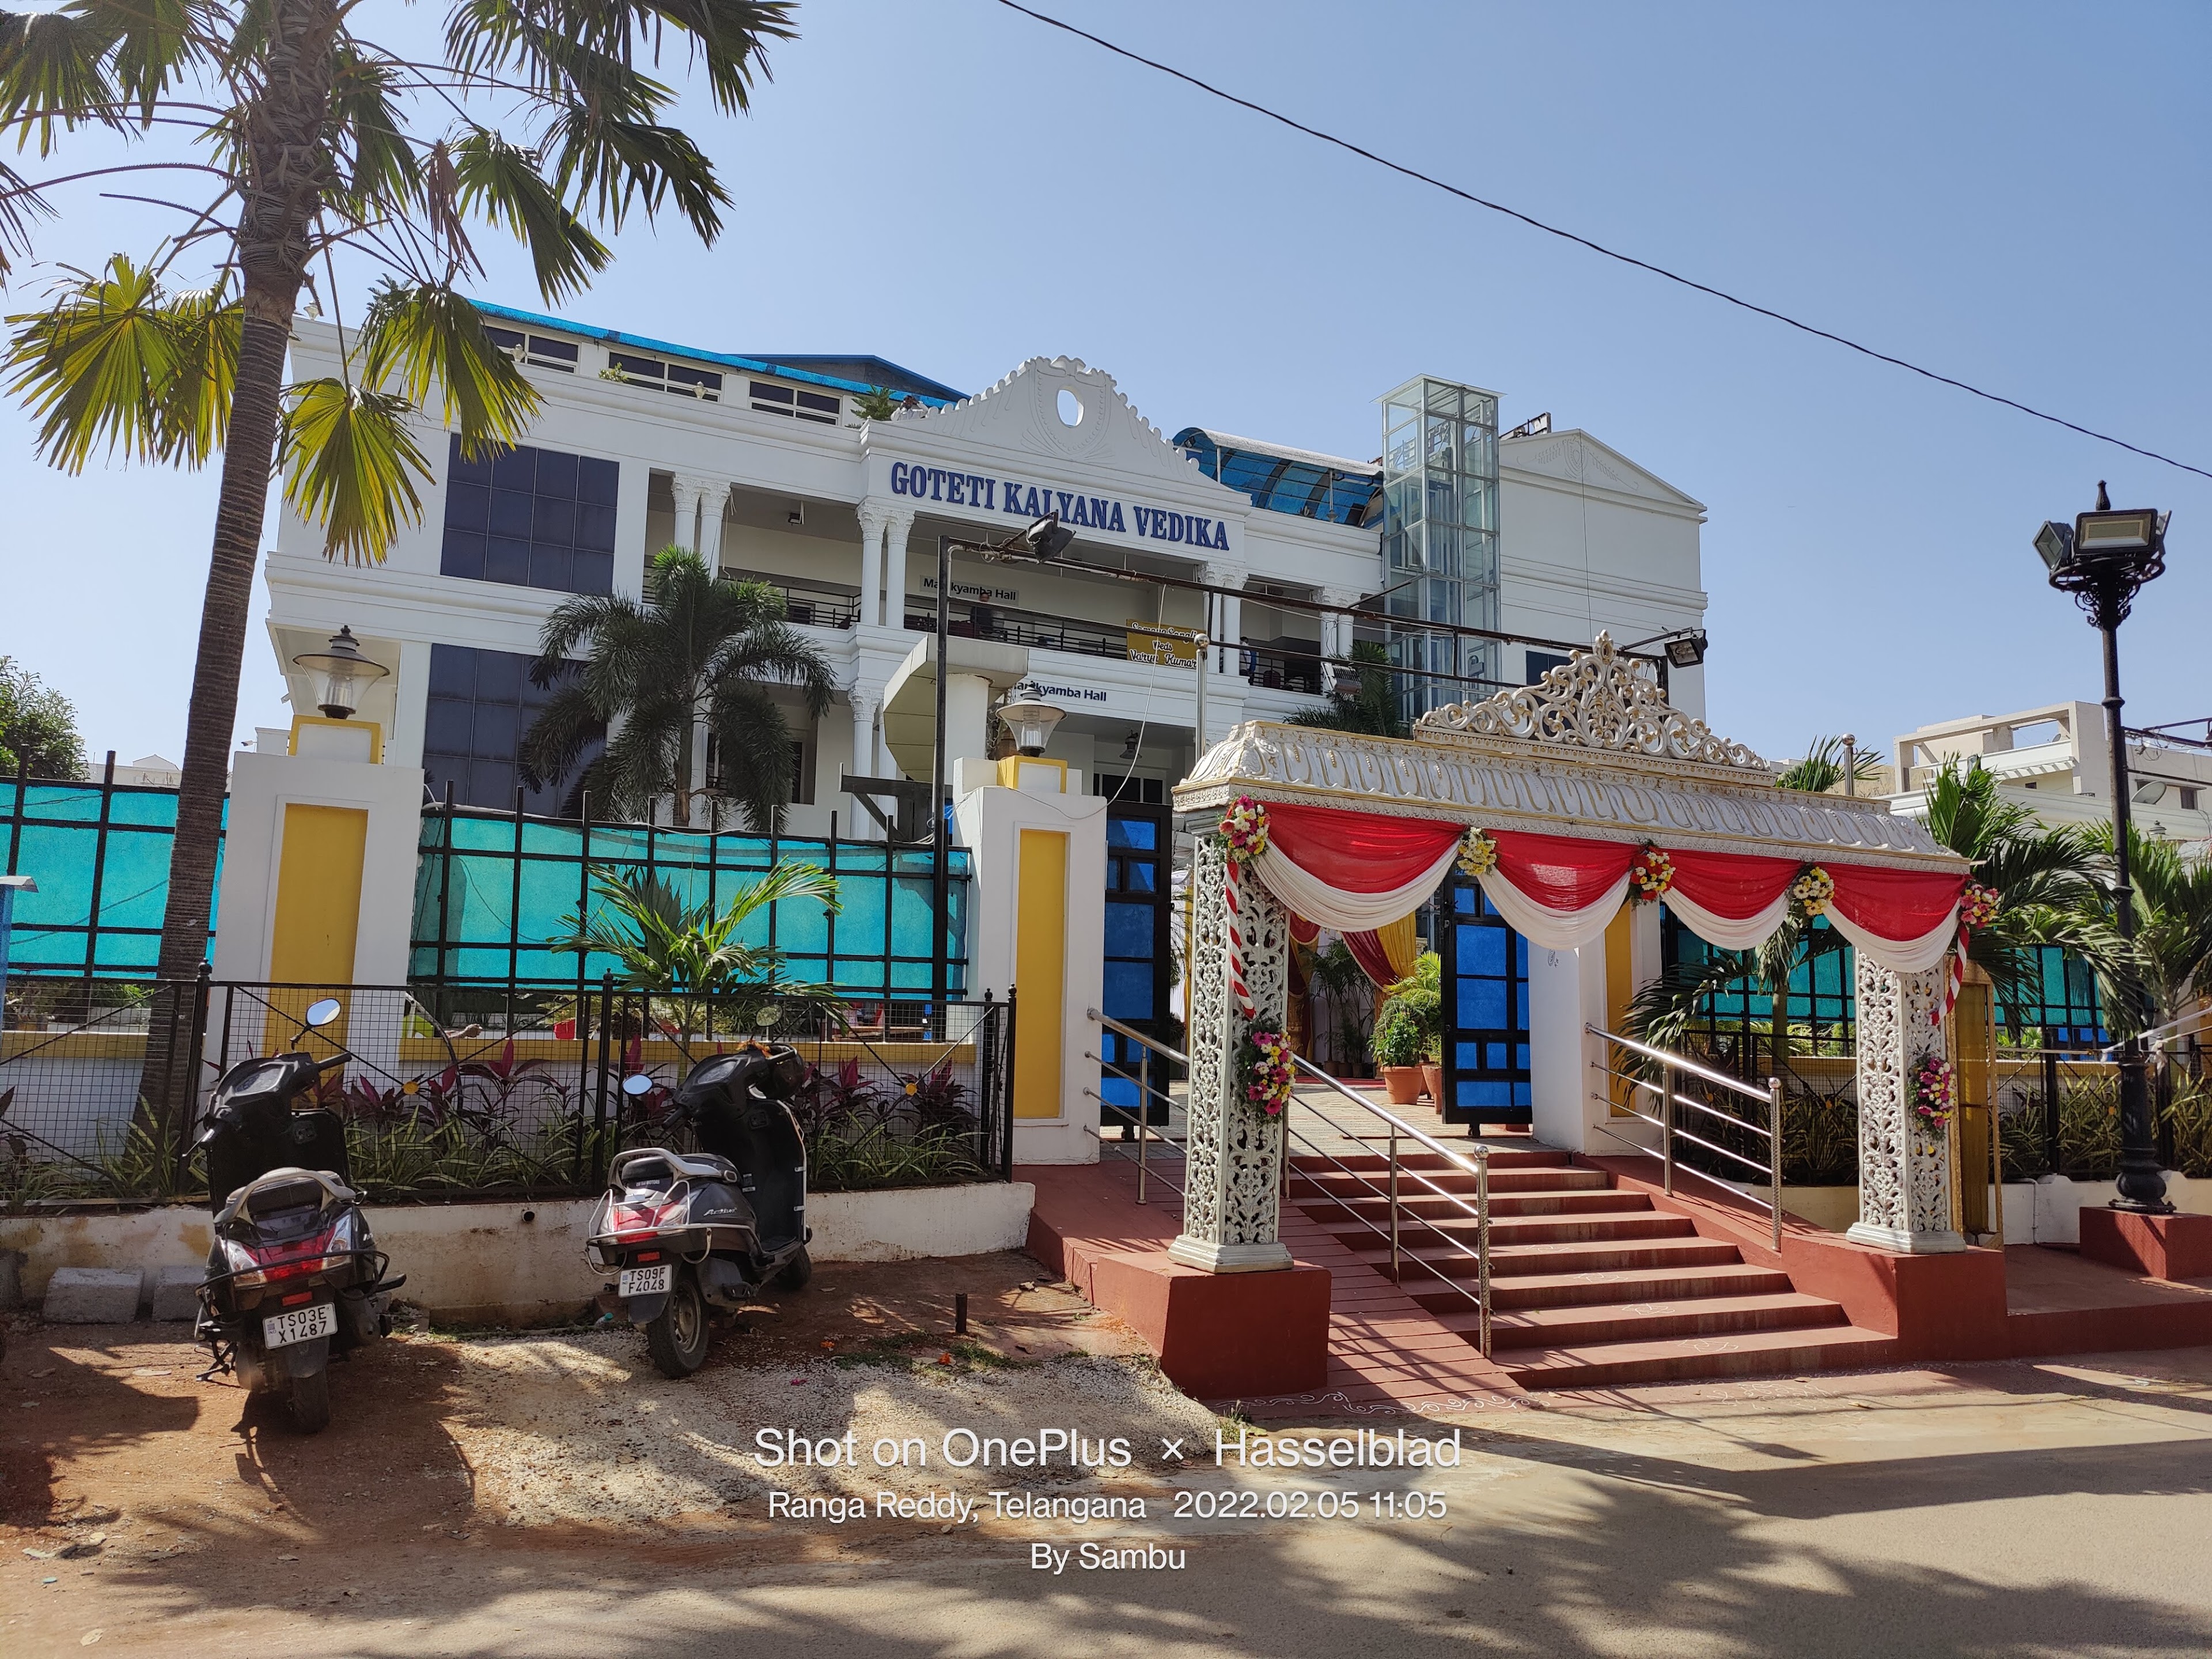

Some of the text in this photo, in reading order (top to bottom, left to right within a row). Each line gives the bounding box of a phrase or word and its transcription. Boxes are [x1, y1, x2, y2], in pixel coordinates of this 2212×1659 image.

[892, 462, 1229, 551] GOTETI KALYANA VEDIKA
[923, 578, 1016, 600] Makyamba Hall
[1152, 640, 1173, 652] Weds
[1129, 649, 1196, 669] Varun Kumar
[1084, 689, 1107, 702] Hall
[630, 1267, 665, 1282] TS09F
[628, 1279, 664, 1294] F4048
[277, 1306, 327, 1329] TS03E
[278, 1320, 327, 1344] X1487
